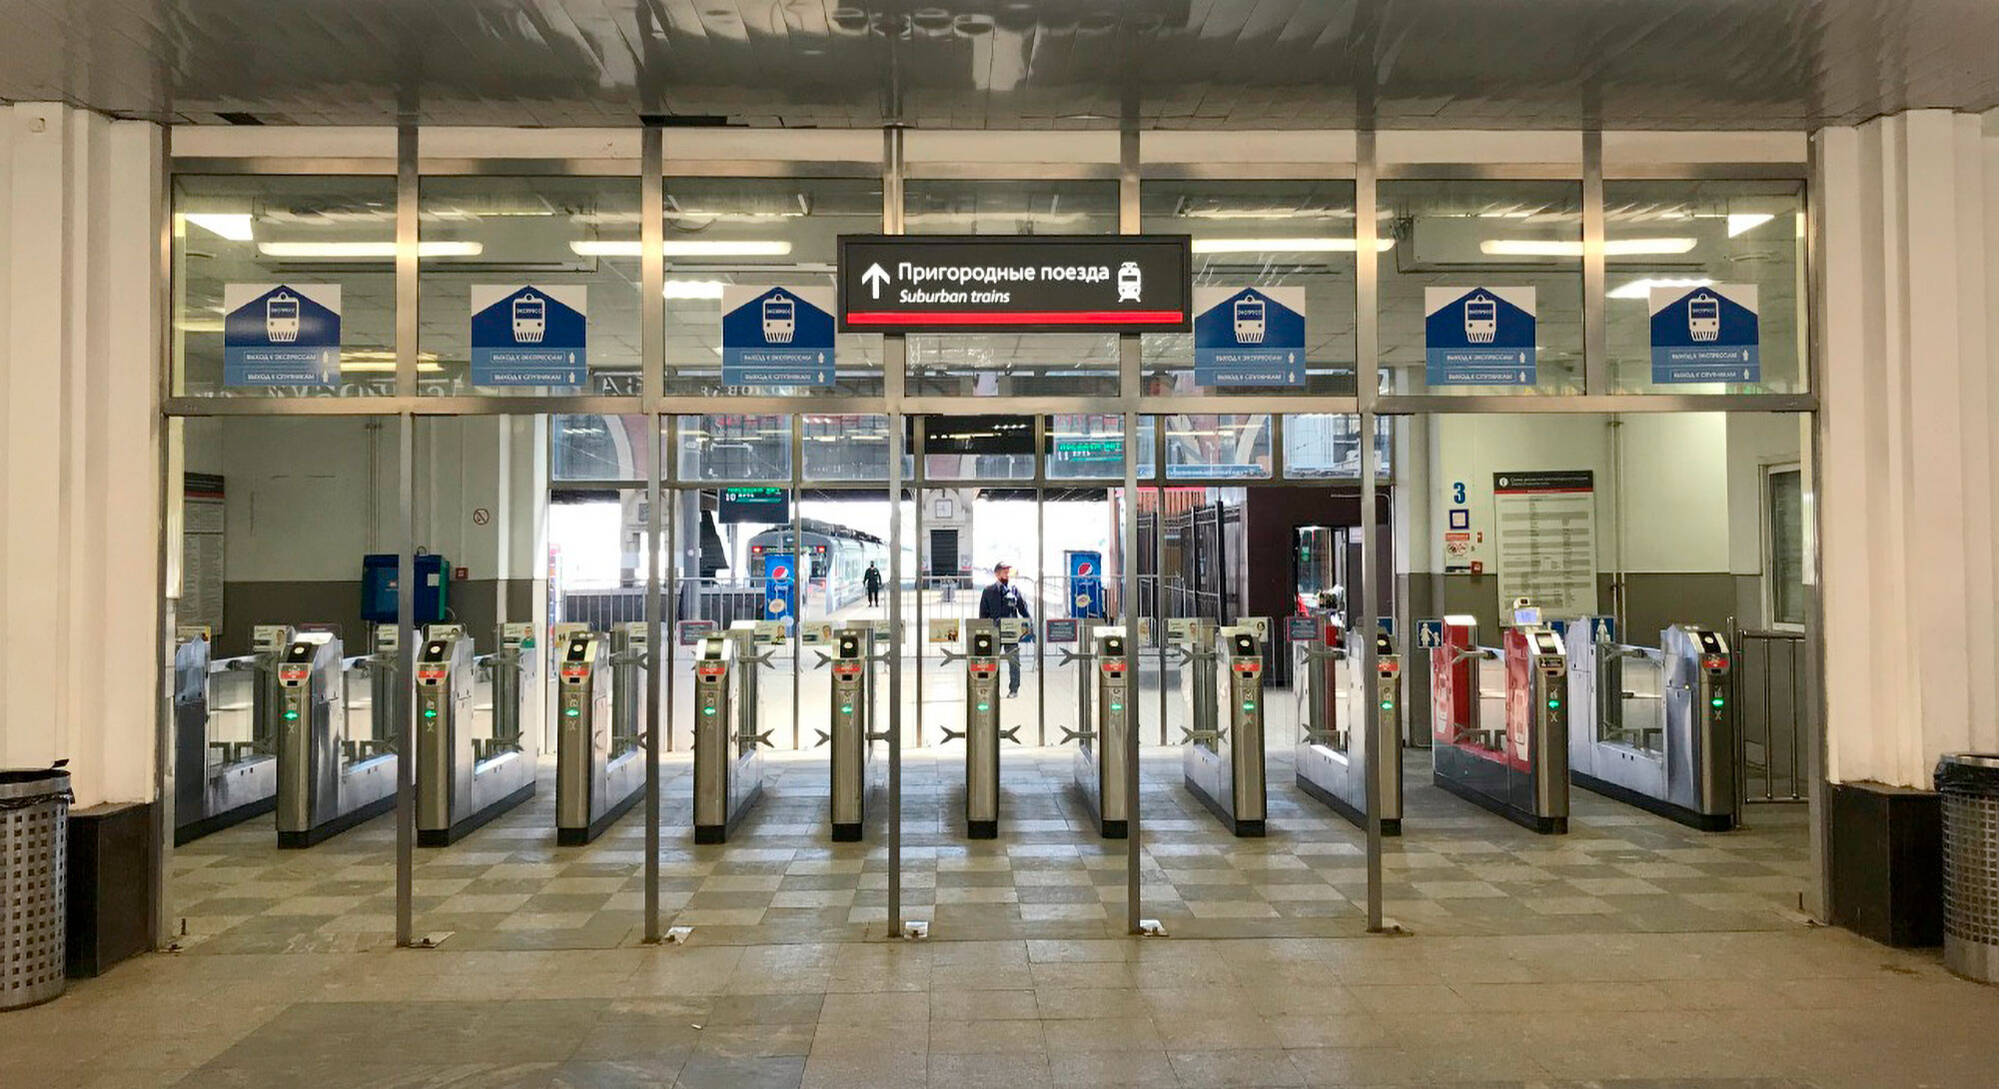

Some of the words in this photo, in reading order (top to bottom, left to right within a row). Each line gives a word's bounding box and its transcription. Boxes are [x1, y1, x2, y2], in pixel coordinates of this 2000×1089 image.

[898, 262, 1036, 285] Пригородные
[1041, 265, 1110, 284] поезда
[899, 288, 968, 303] Suburban
[970, 289, 1010, 303] trains
[725, 493, 736, 502] 10
[1453, 482, 1466, 504] 3
